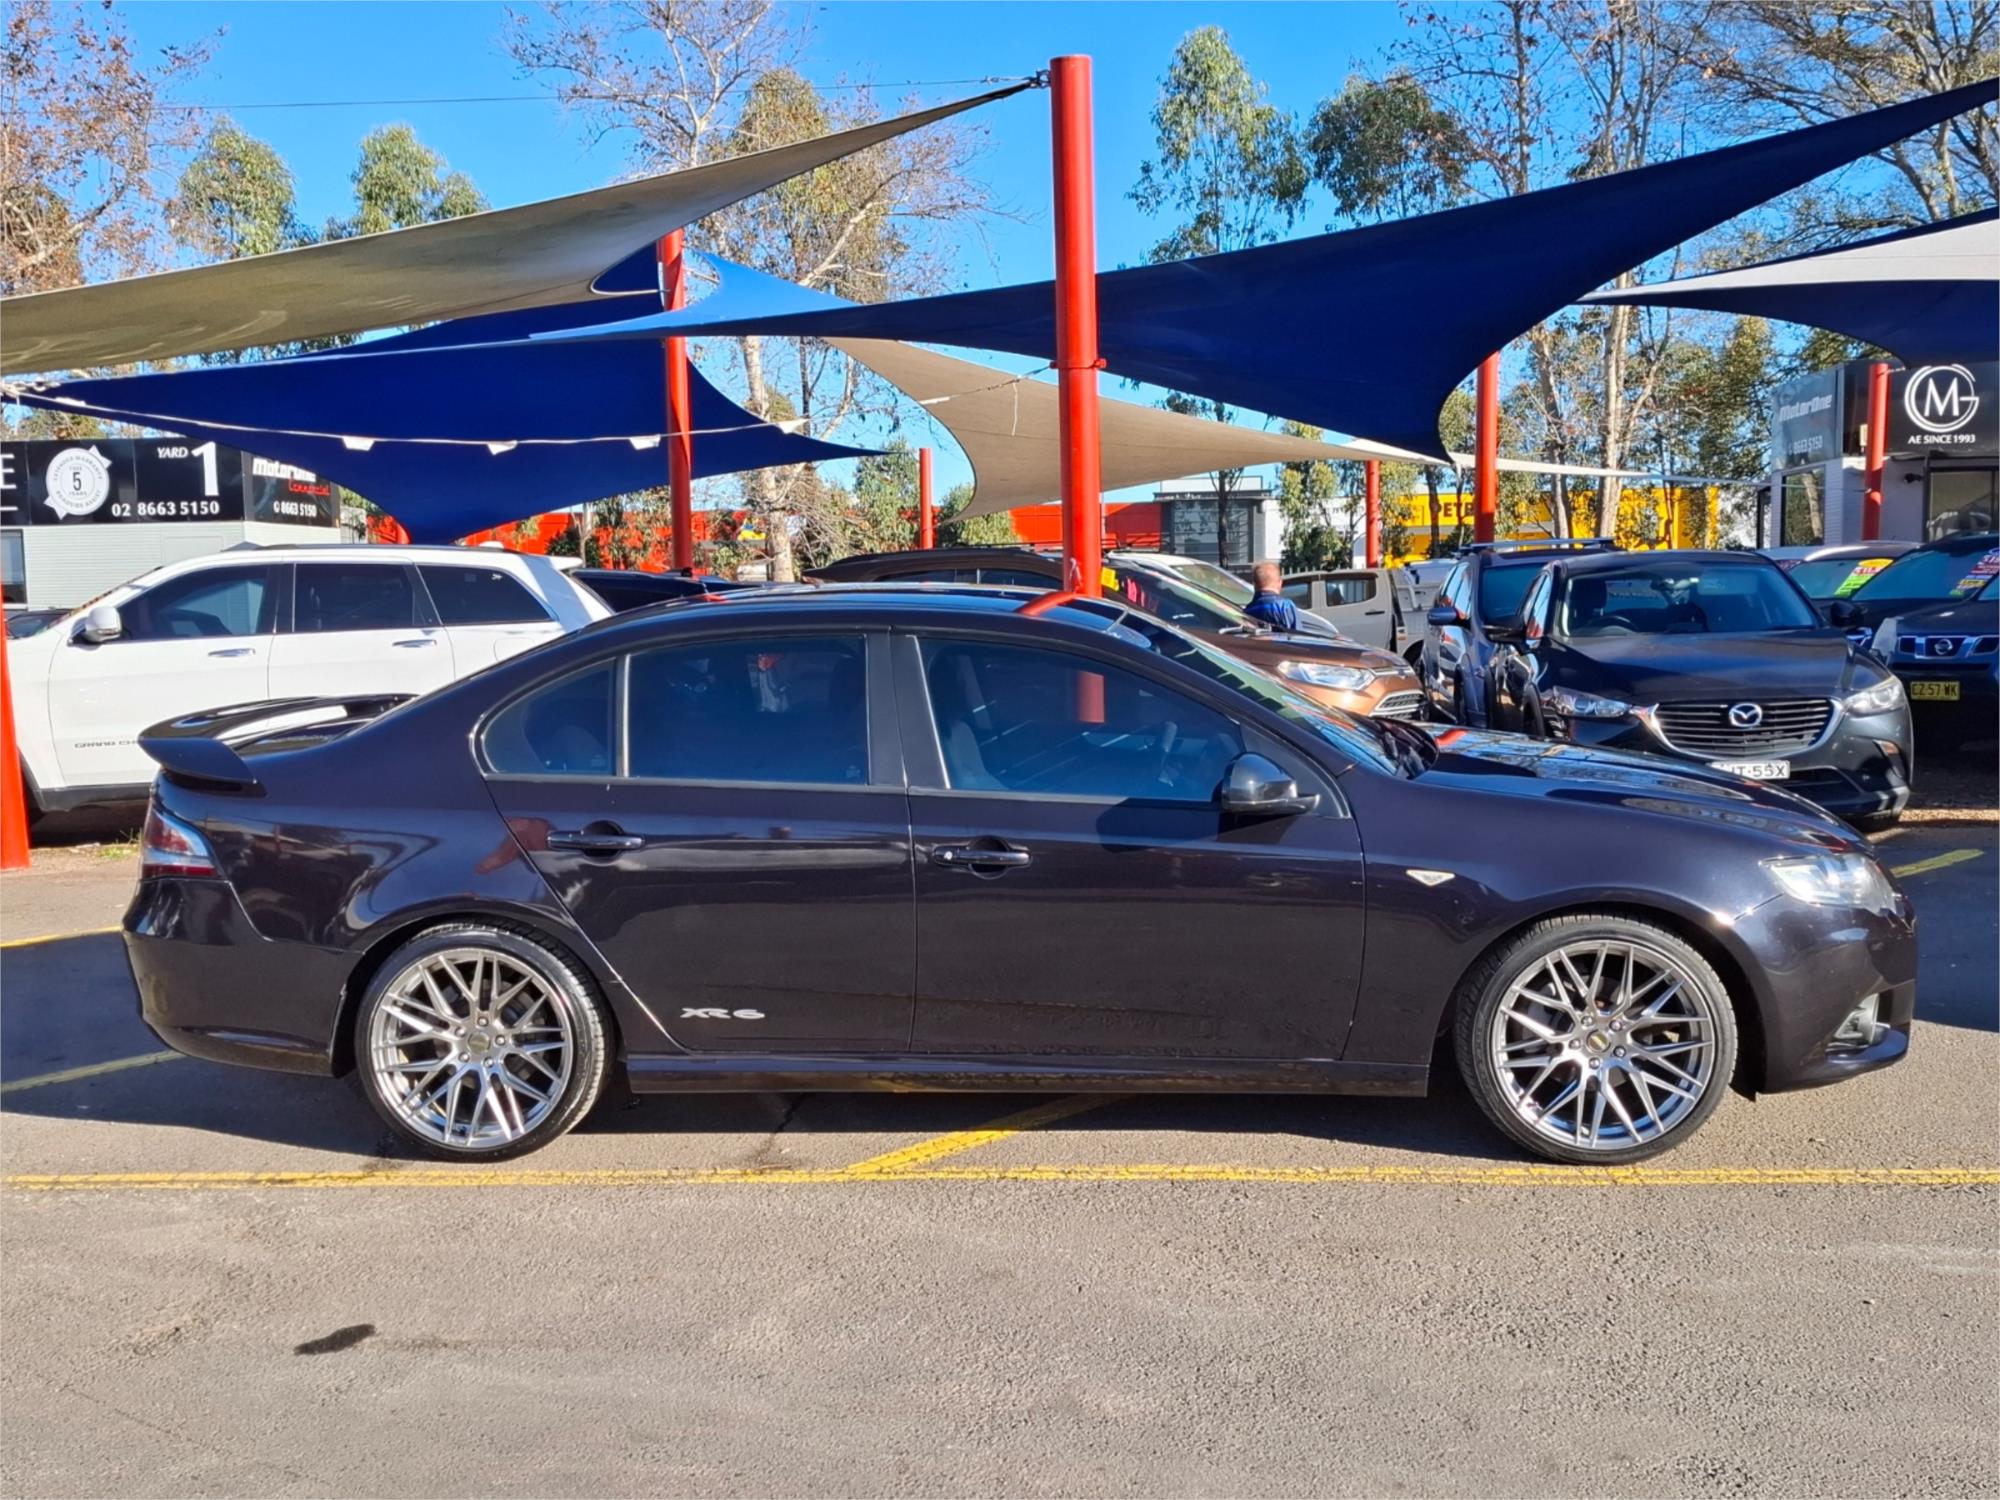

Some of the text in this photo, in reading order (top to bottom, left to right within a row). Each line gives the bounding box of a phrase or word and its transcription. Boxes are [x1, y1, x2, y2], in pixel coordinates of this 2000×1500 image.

[1923, 434, 1953, 444] SINCE
[1953, 434, 1976, 444] 1993
[156, 440, 219, 497] YARD 1
[72, 471, 82, 491] 5
[111, 500, 220, 517] 02 8663 5150
[280, 500, 317, 518] 8663 5150
[679, 1007, 766, 1020] XR6
